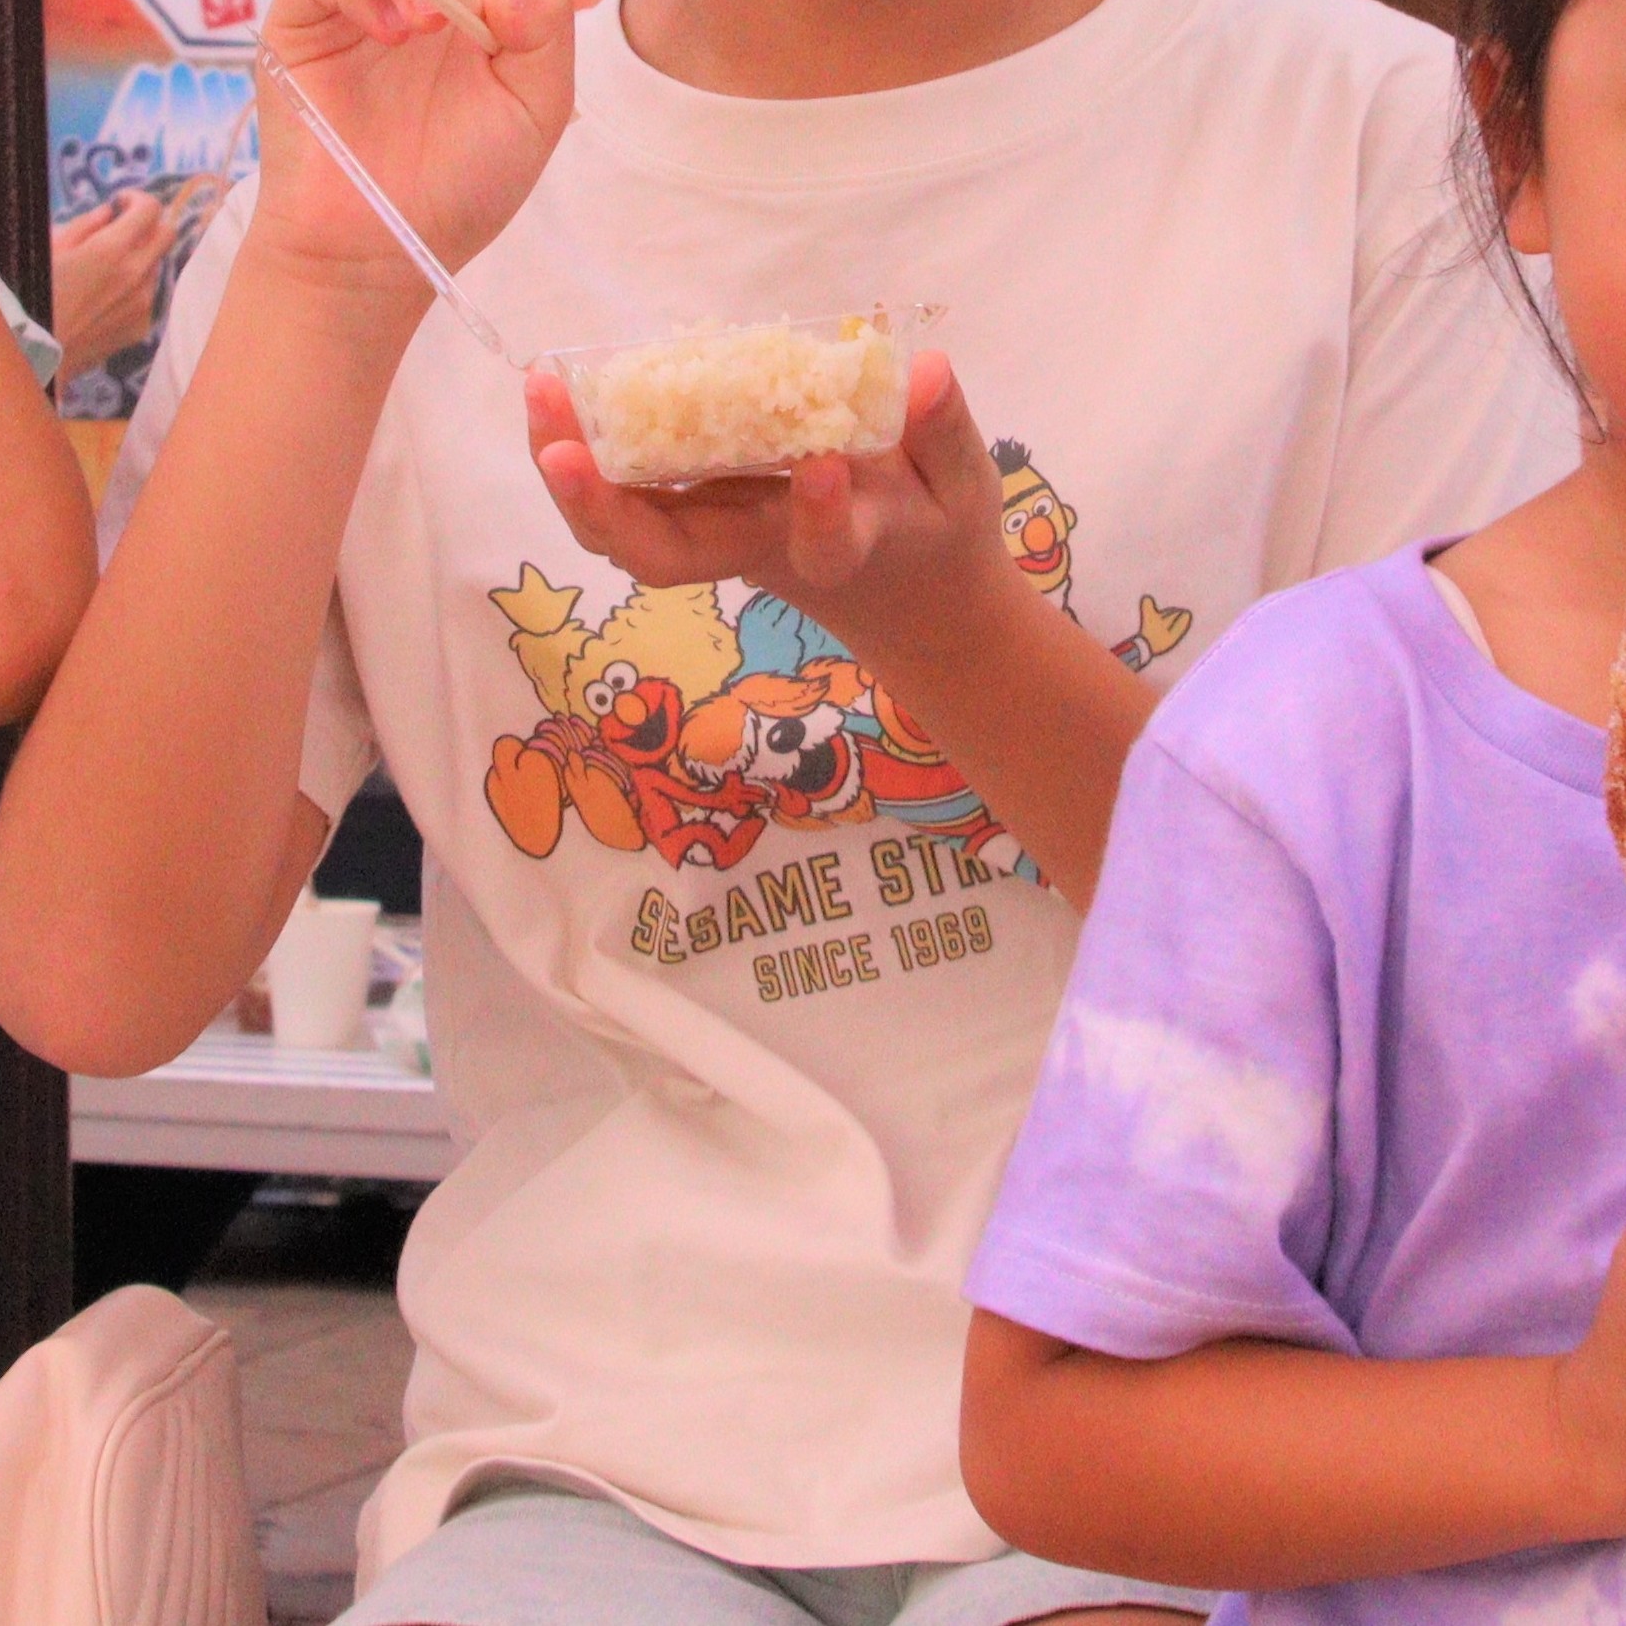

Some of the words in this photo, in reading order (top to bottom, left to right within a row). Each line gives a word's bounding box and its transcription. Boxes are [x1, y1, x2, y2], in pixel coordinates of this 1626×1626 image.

[631, 851, 854, 965] SESAME
[870, 834, 1019, 908] STR
[753, 934, 880, 1003] SINCE
[890, 905, 994, 971] 1969
